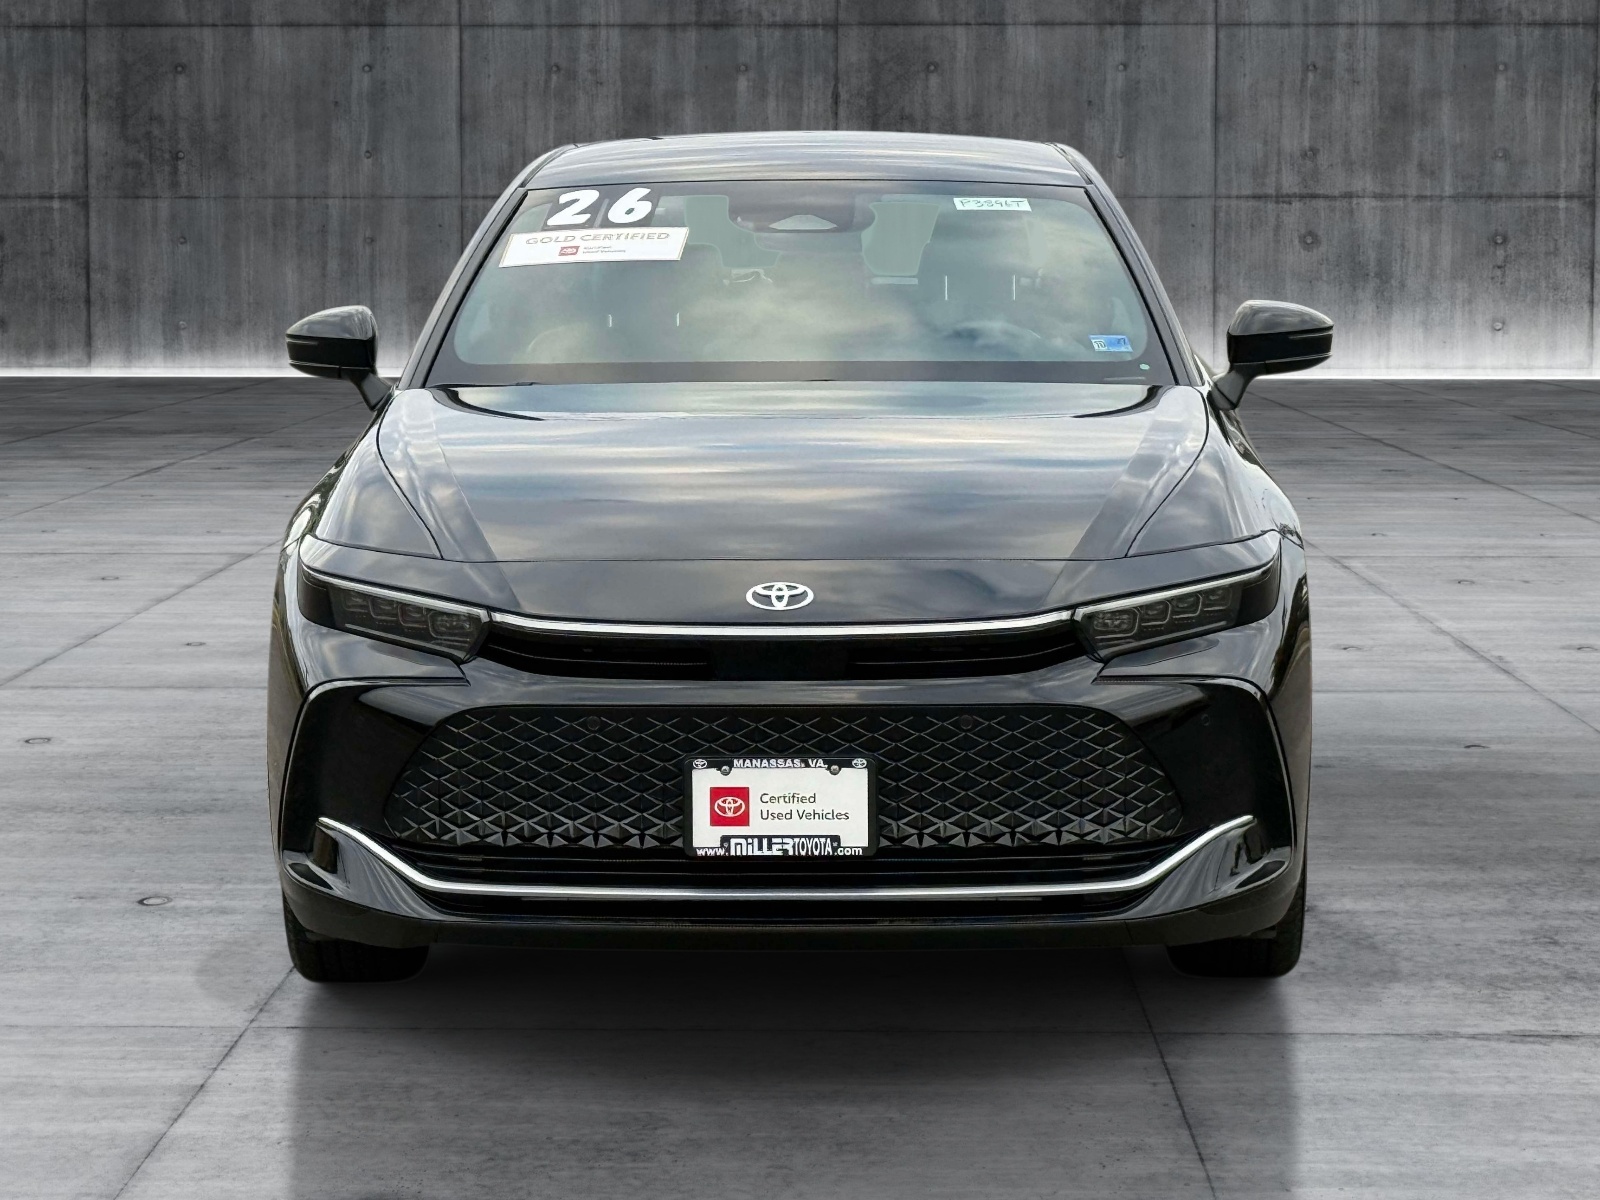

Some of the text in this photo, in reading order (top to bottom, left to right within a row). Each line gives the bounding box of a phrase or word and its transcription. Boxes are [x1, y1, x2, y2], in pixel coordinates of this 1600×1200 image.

[526, 232, 671, 245] GOLD CERTIFIED
[760, 793, 817, 804] Certified
[760, 809, 850, 821] Used Vehicles
